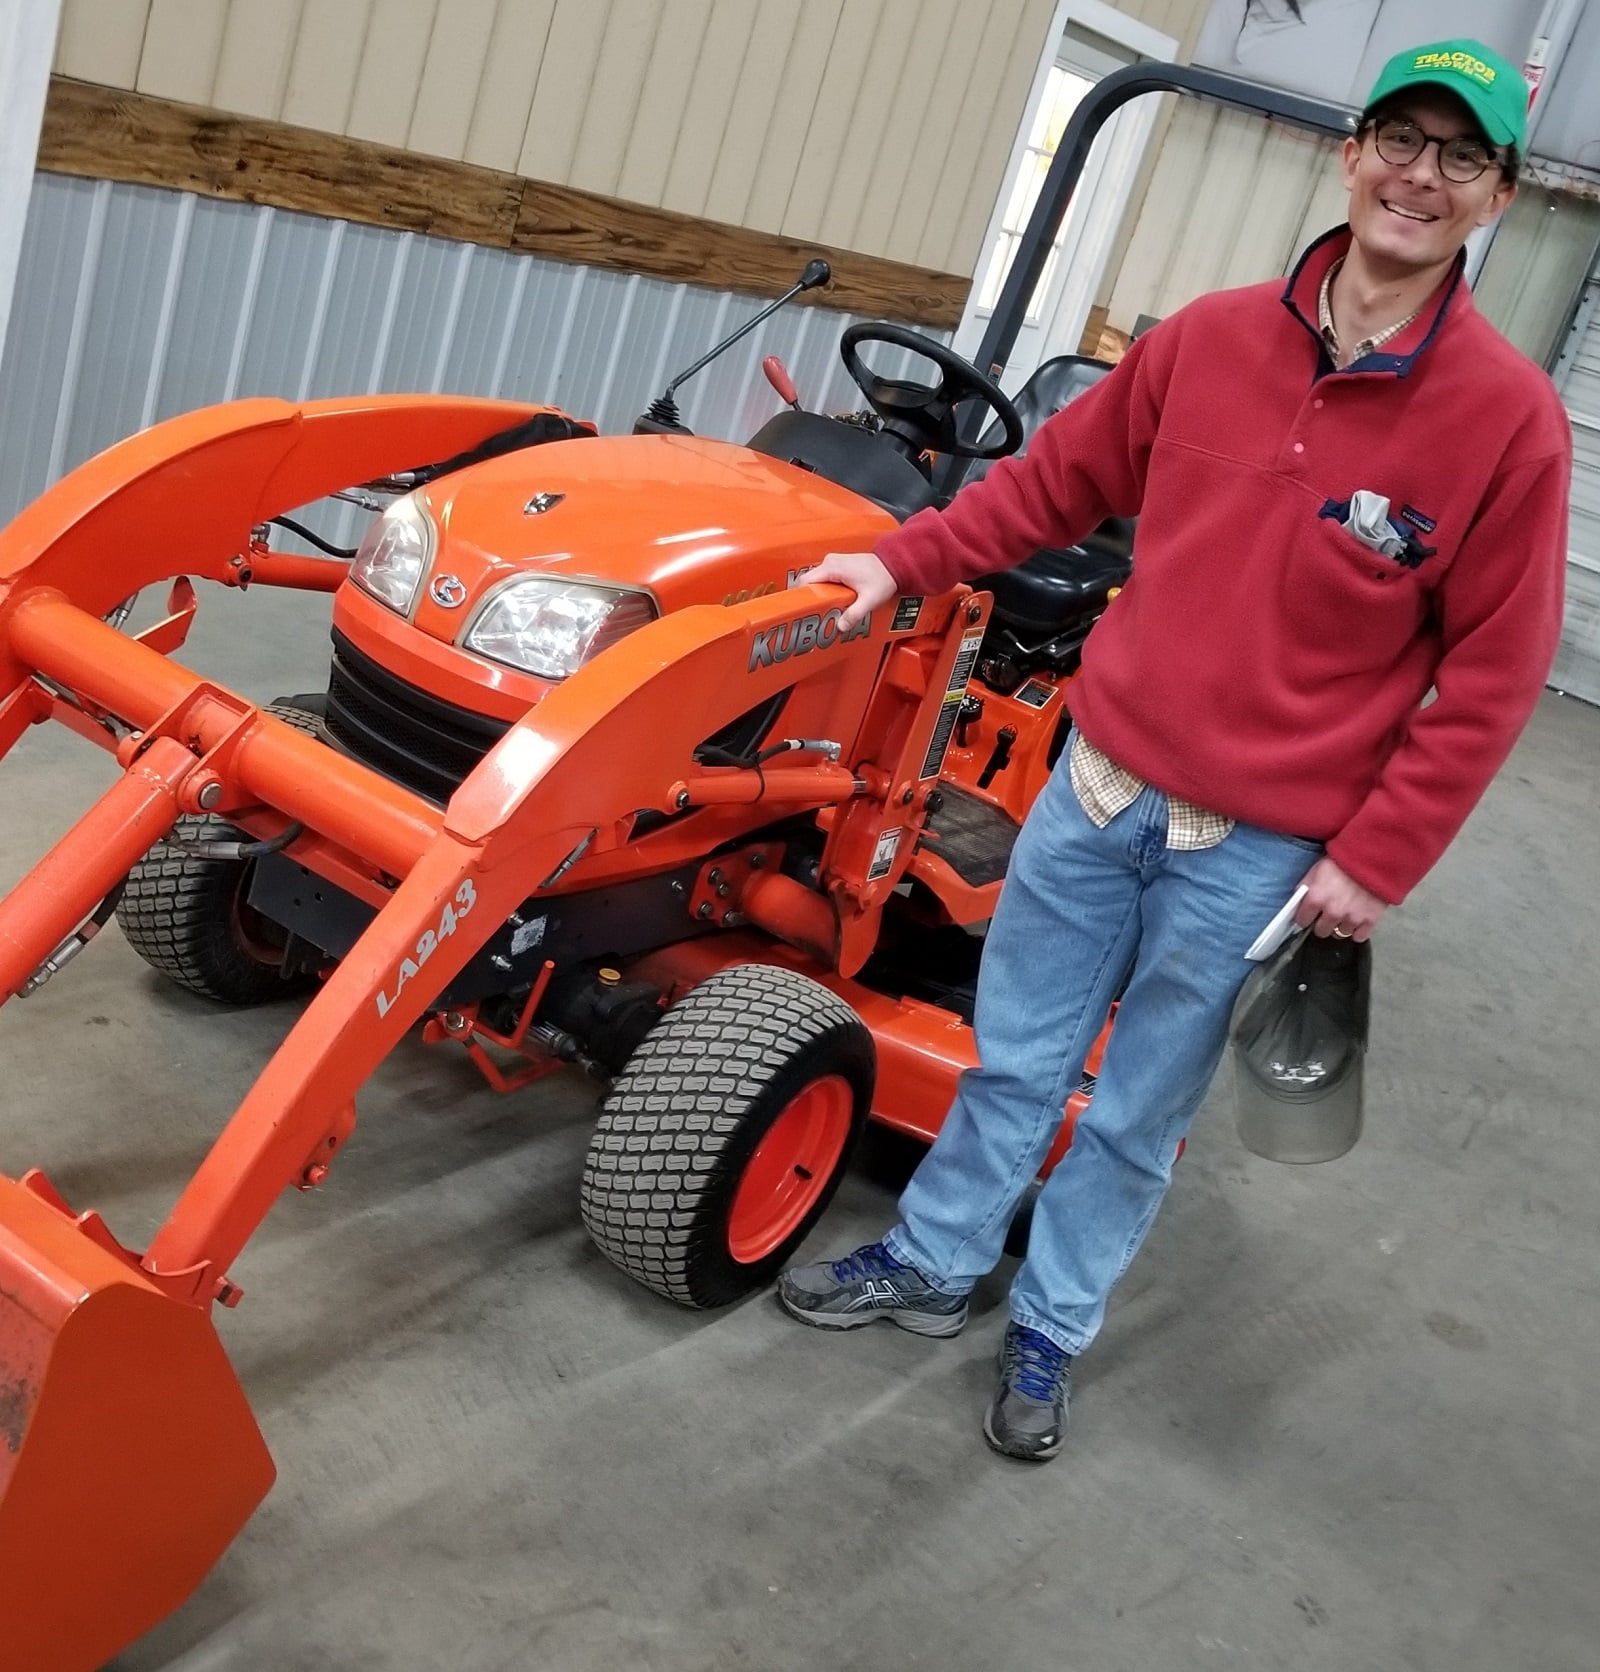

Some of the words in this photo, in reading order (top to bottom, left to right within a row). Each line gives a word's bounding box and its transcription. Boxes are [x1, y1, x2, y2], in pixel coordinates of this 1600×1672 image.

[1415, 52, 1496, 81] TRACTOR
[1433, 61, 1473, 75] TOWN
[747, 608, 873, 674] KUBOA
[376, 878, 477, 1019] LA243
